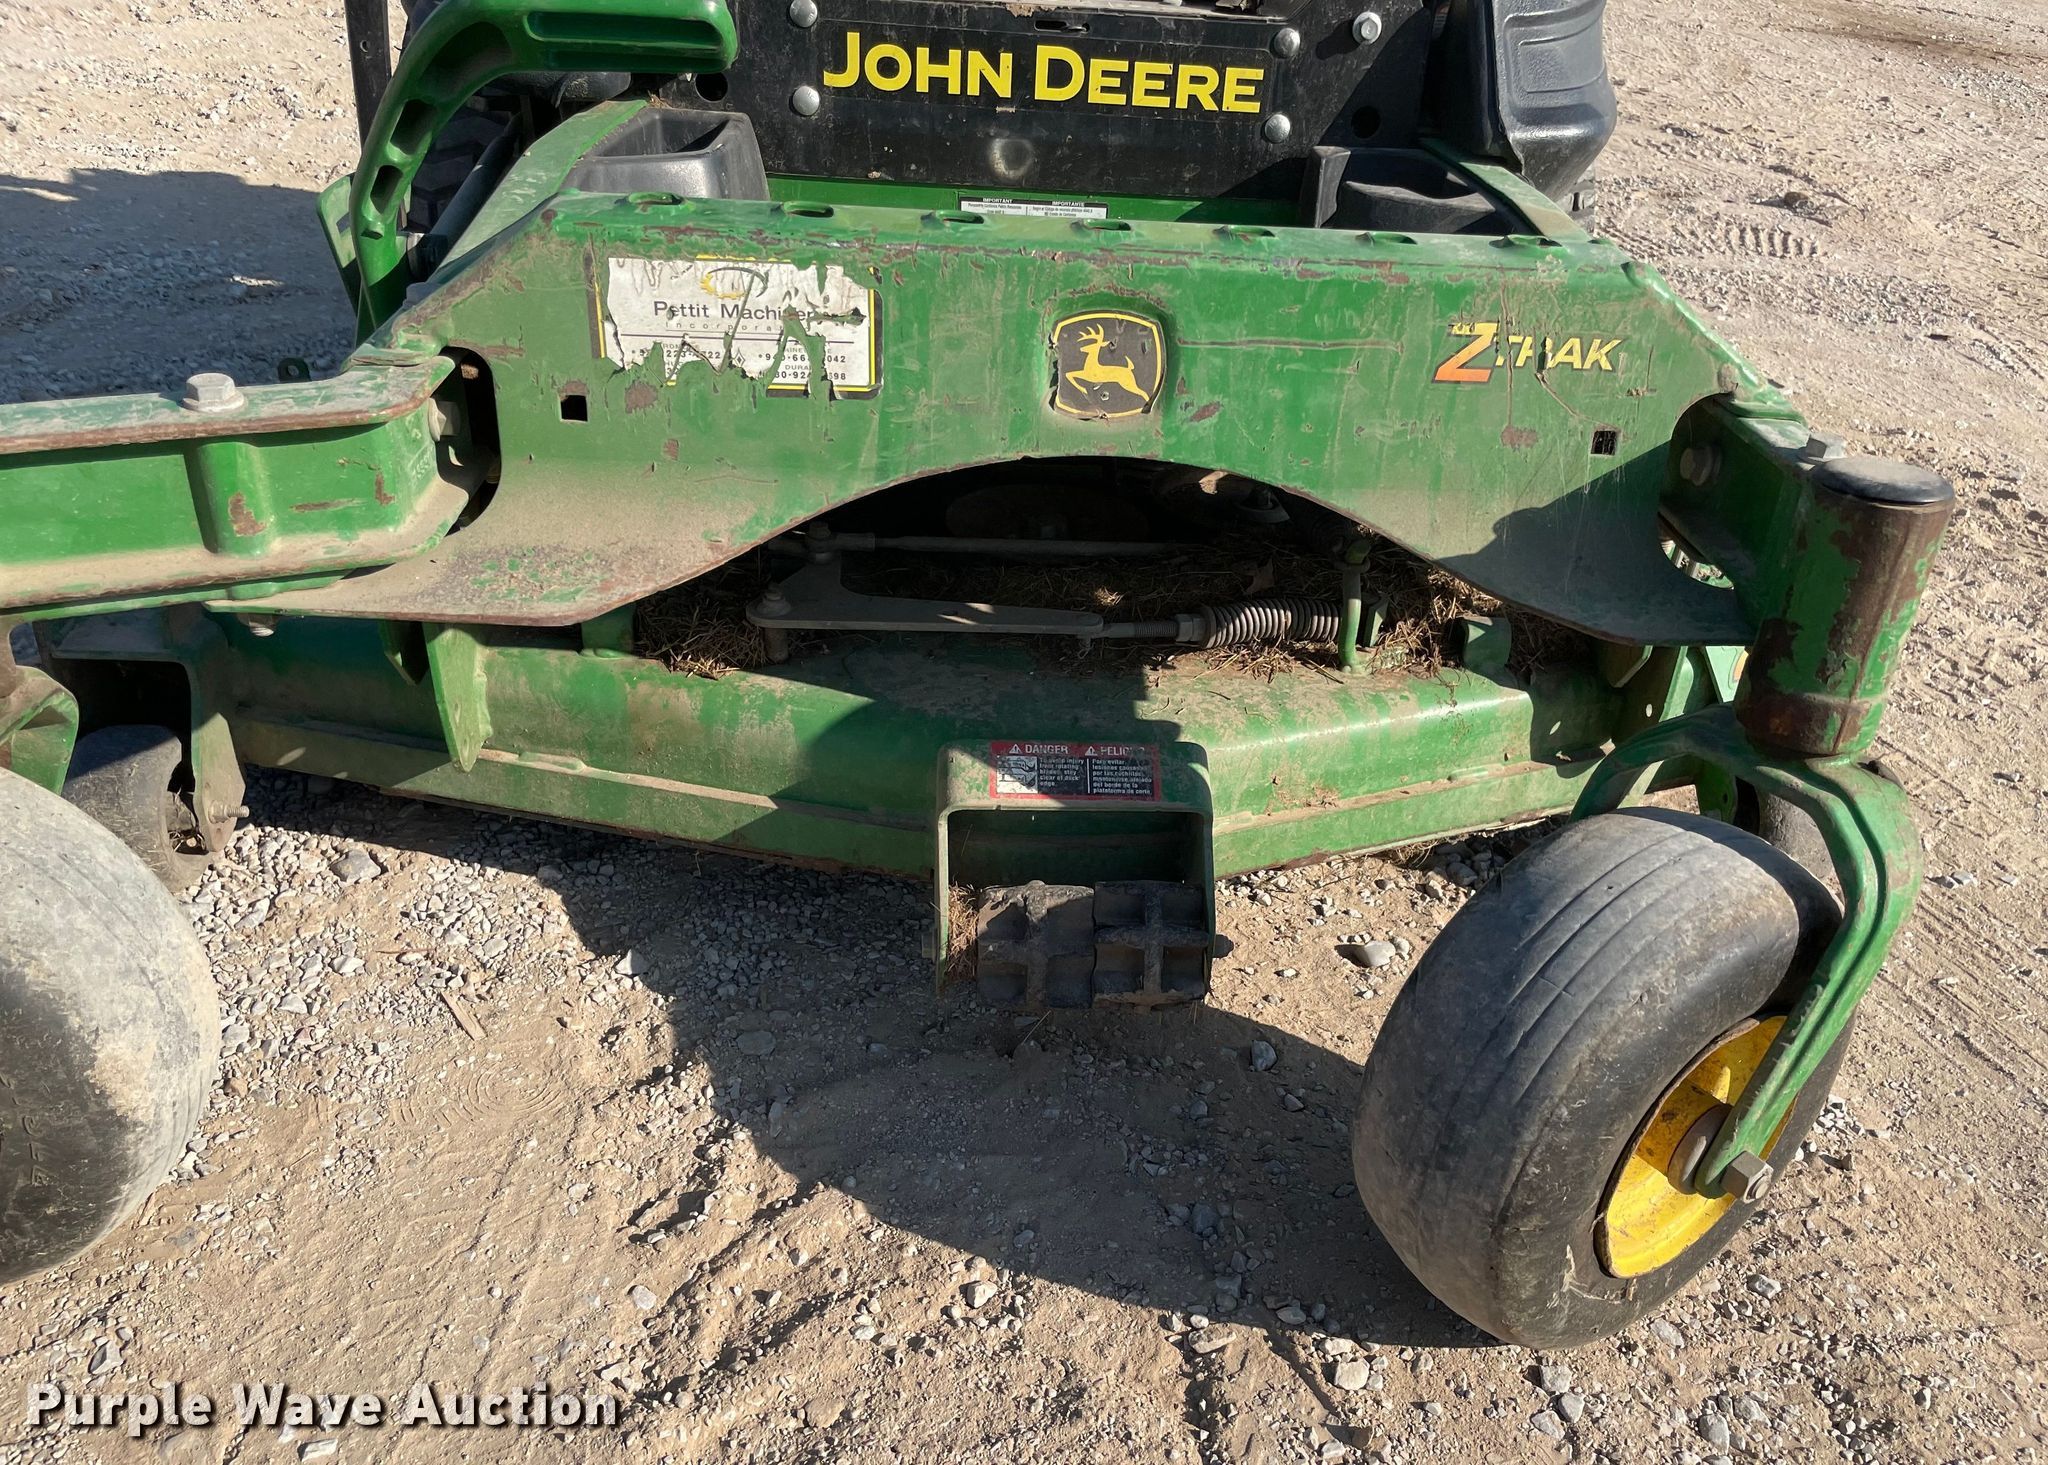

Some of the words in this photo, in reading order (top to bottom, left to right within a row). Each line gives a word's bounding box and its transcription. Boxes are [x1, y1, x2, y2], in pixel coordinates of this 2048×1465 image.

[822, 31, 1013, 99] JOHN
[1034, 44, 1265, 114] DEERE
[654, 300, 710, 319] Pettit
[1025, 744, 1069, 755] DANGER
